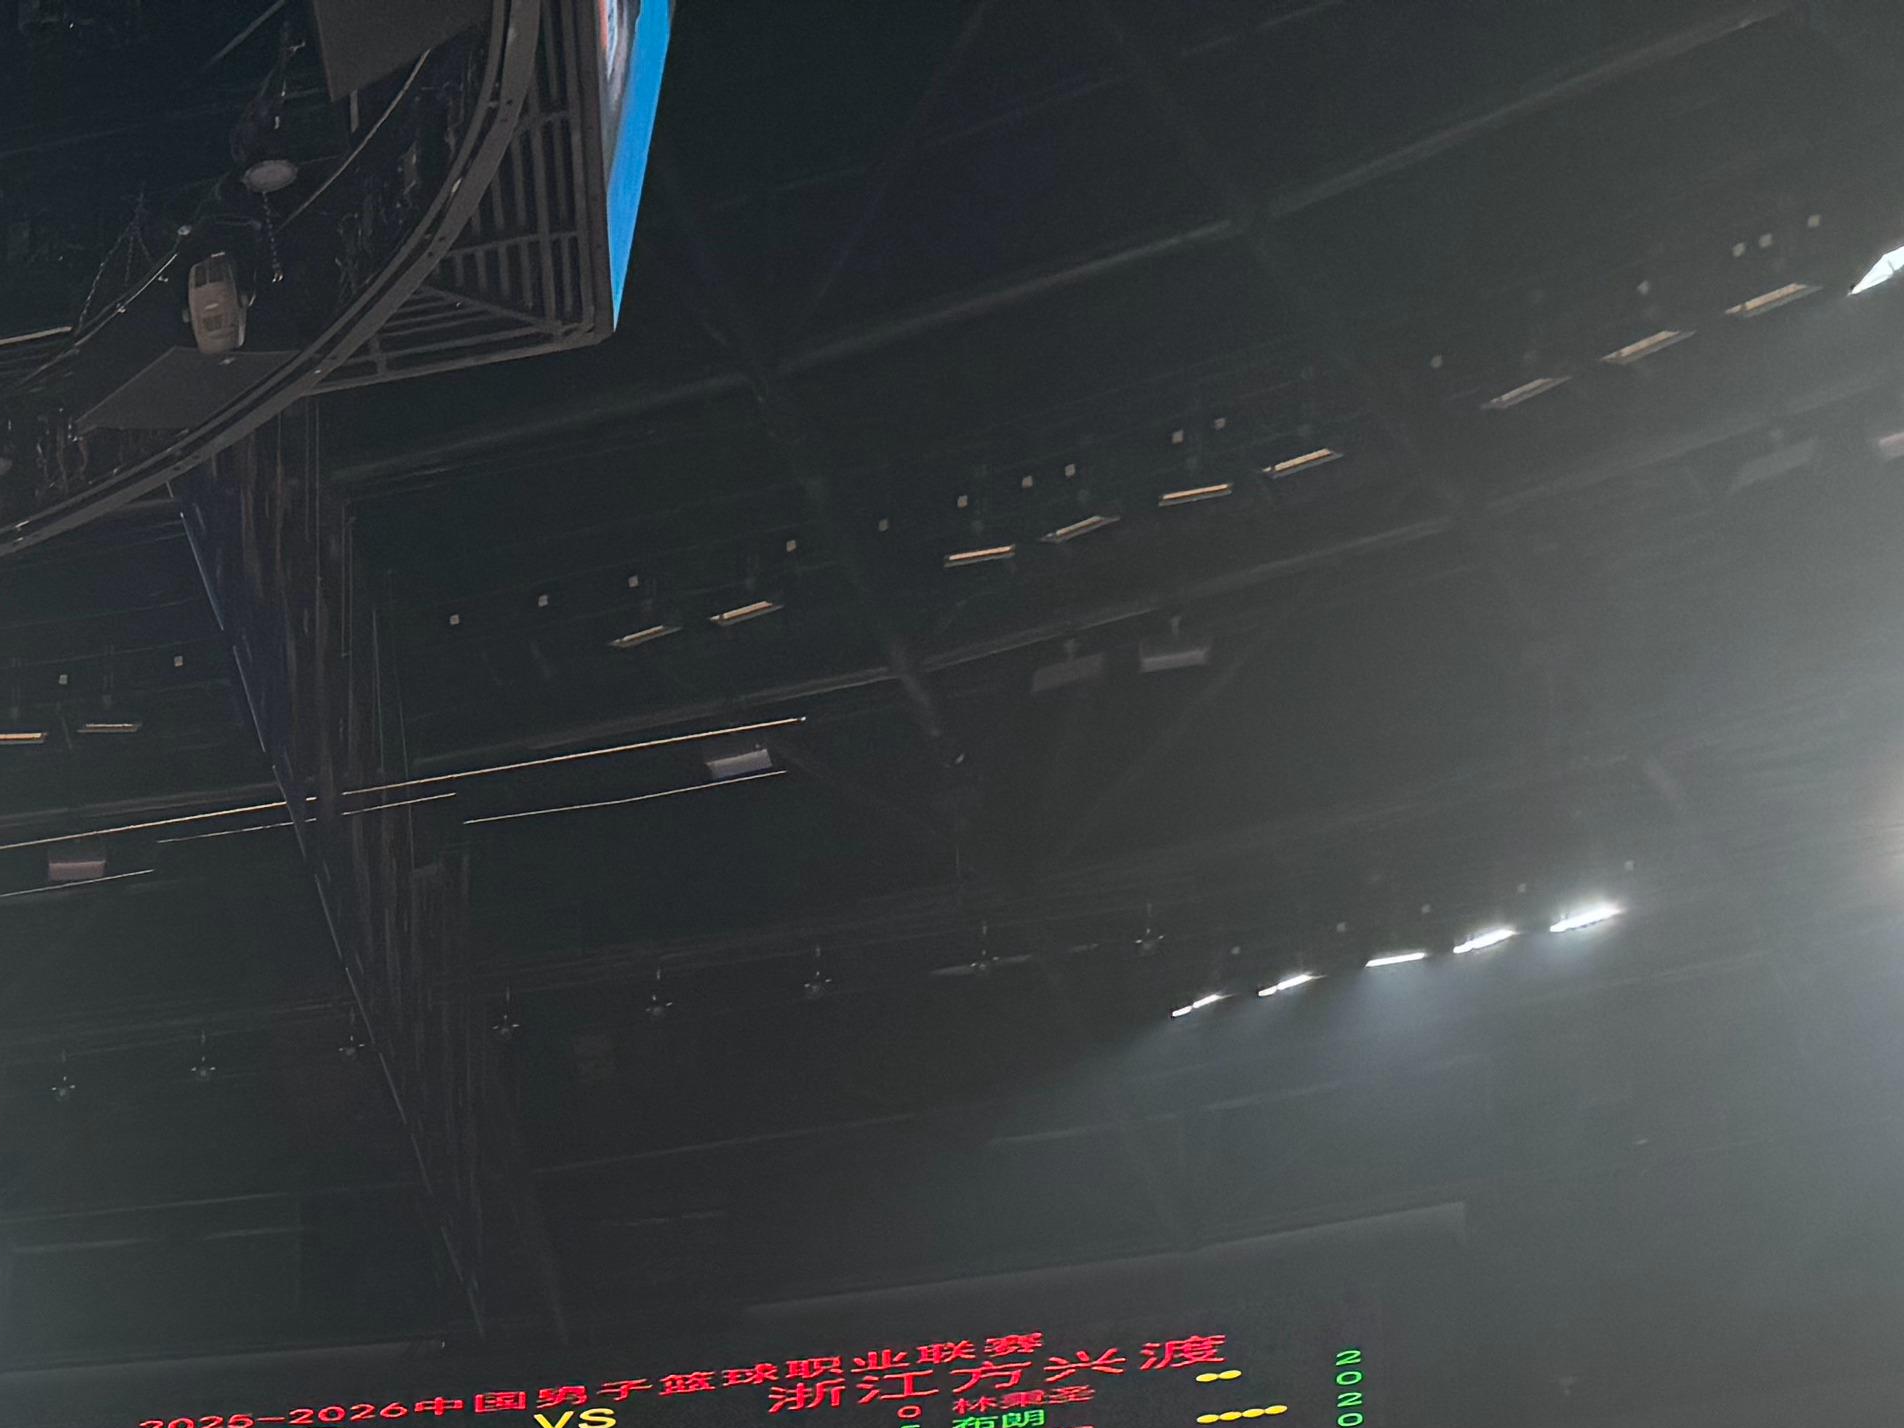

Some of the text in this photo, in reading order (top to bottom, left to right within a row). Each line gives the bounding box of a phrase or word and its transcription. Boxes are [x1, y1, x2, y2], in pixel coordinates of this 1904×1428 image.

[769, 1334, 1226, 1414] 浙江方兴渡
[1336, 1371, 1362, 1385] 0
[897, 1405, 922, 1419] 0
[1336, 1350, 1361, 1366] 2
[1337, 1392, 1362, 1407] 2
[1338, 1413, 1363, 1427] 0
